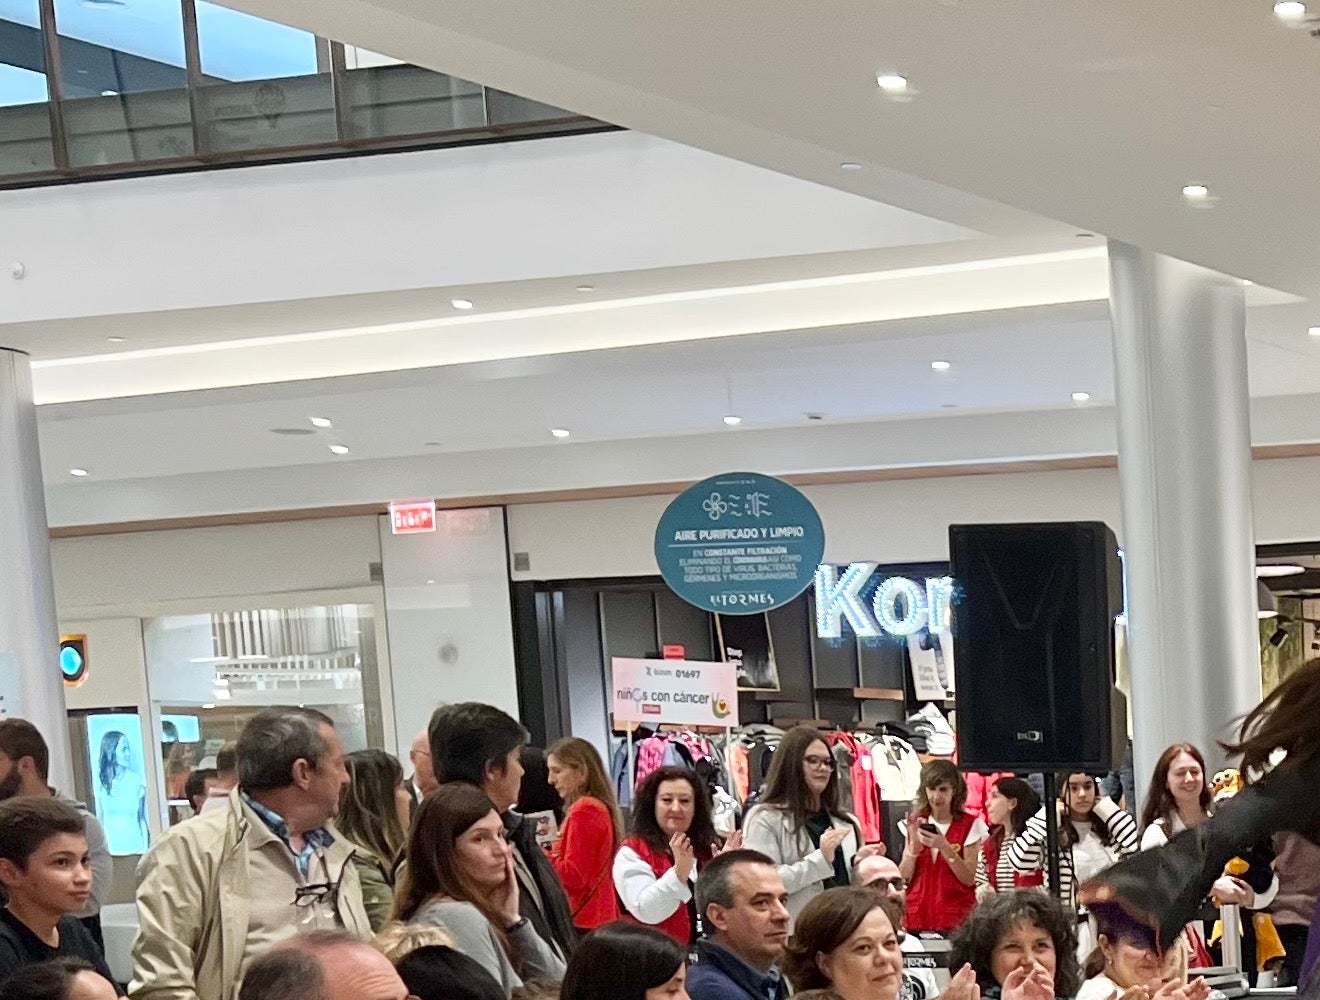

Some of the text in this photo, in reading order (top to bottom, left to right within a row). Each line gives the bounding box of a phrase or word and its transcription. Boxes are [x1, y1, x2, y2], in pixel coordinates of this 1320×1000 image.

[674, 526, 804, 541] AIRE PURIFICADO Y LIMPIO
[675, 669, 701, 679] 01697
[651, 691, 670, 702] con
[673, 690, 709, 704] cáncer
